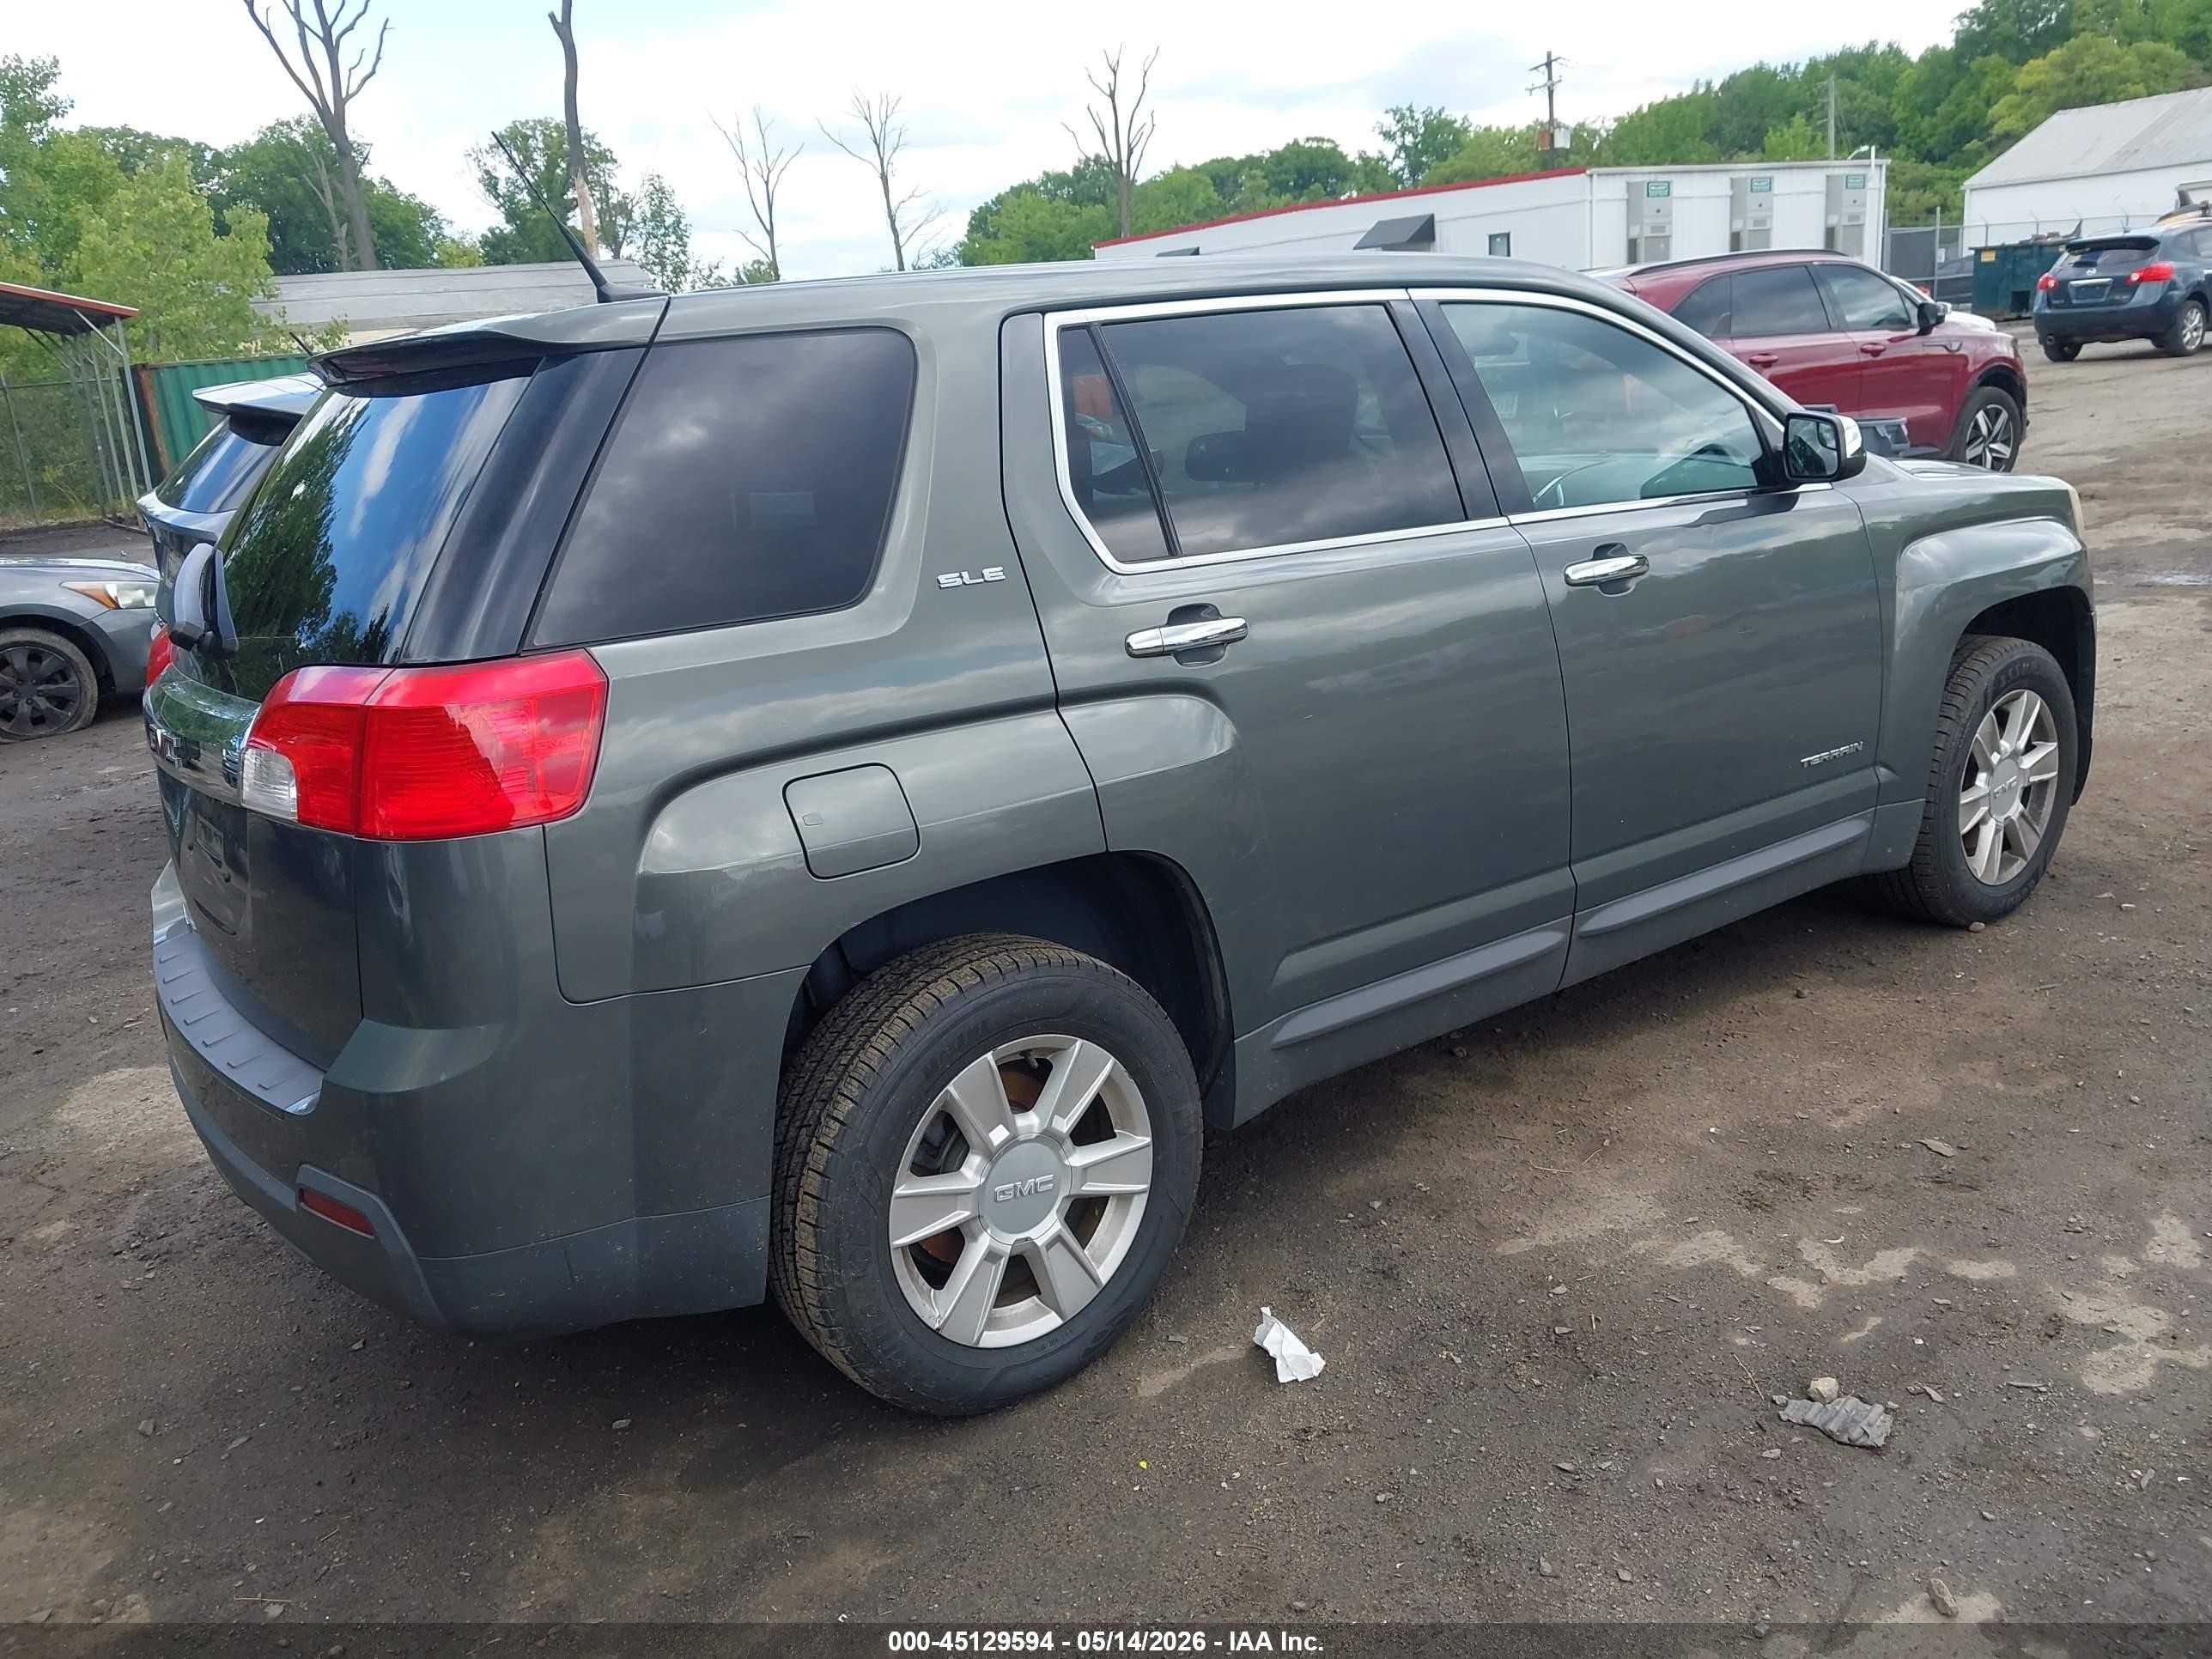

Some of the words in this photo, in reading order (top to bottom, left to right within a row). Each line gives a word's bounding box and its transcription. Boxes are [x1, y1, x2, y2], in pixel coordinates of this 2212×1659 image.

[937, 566, 1006, 589] SLE
[535, 734, 579, 750] GMC
[1800, 741, 1863, 768] TERRAIN
[994, 1174, 1054, 1202] GMC
